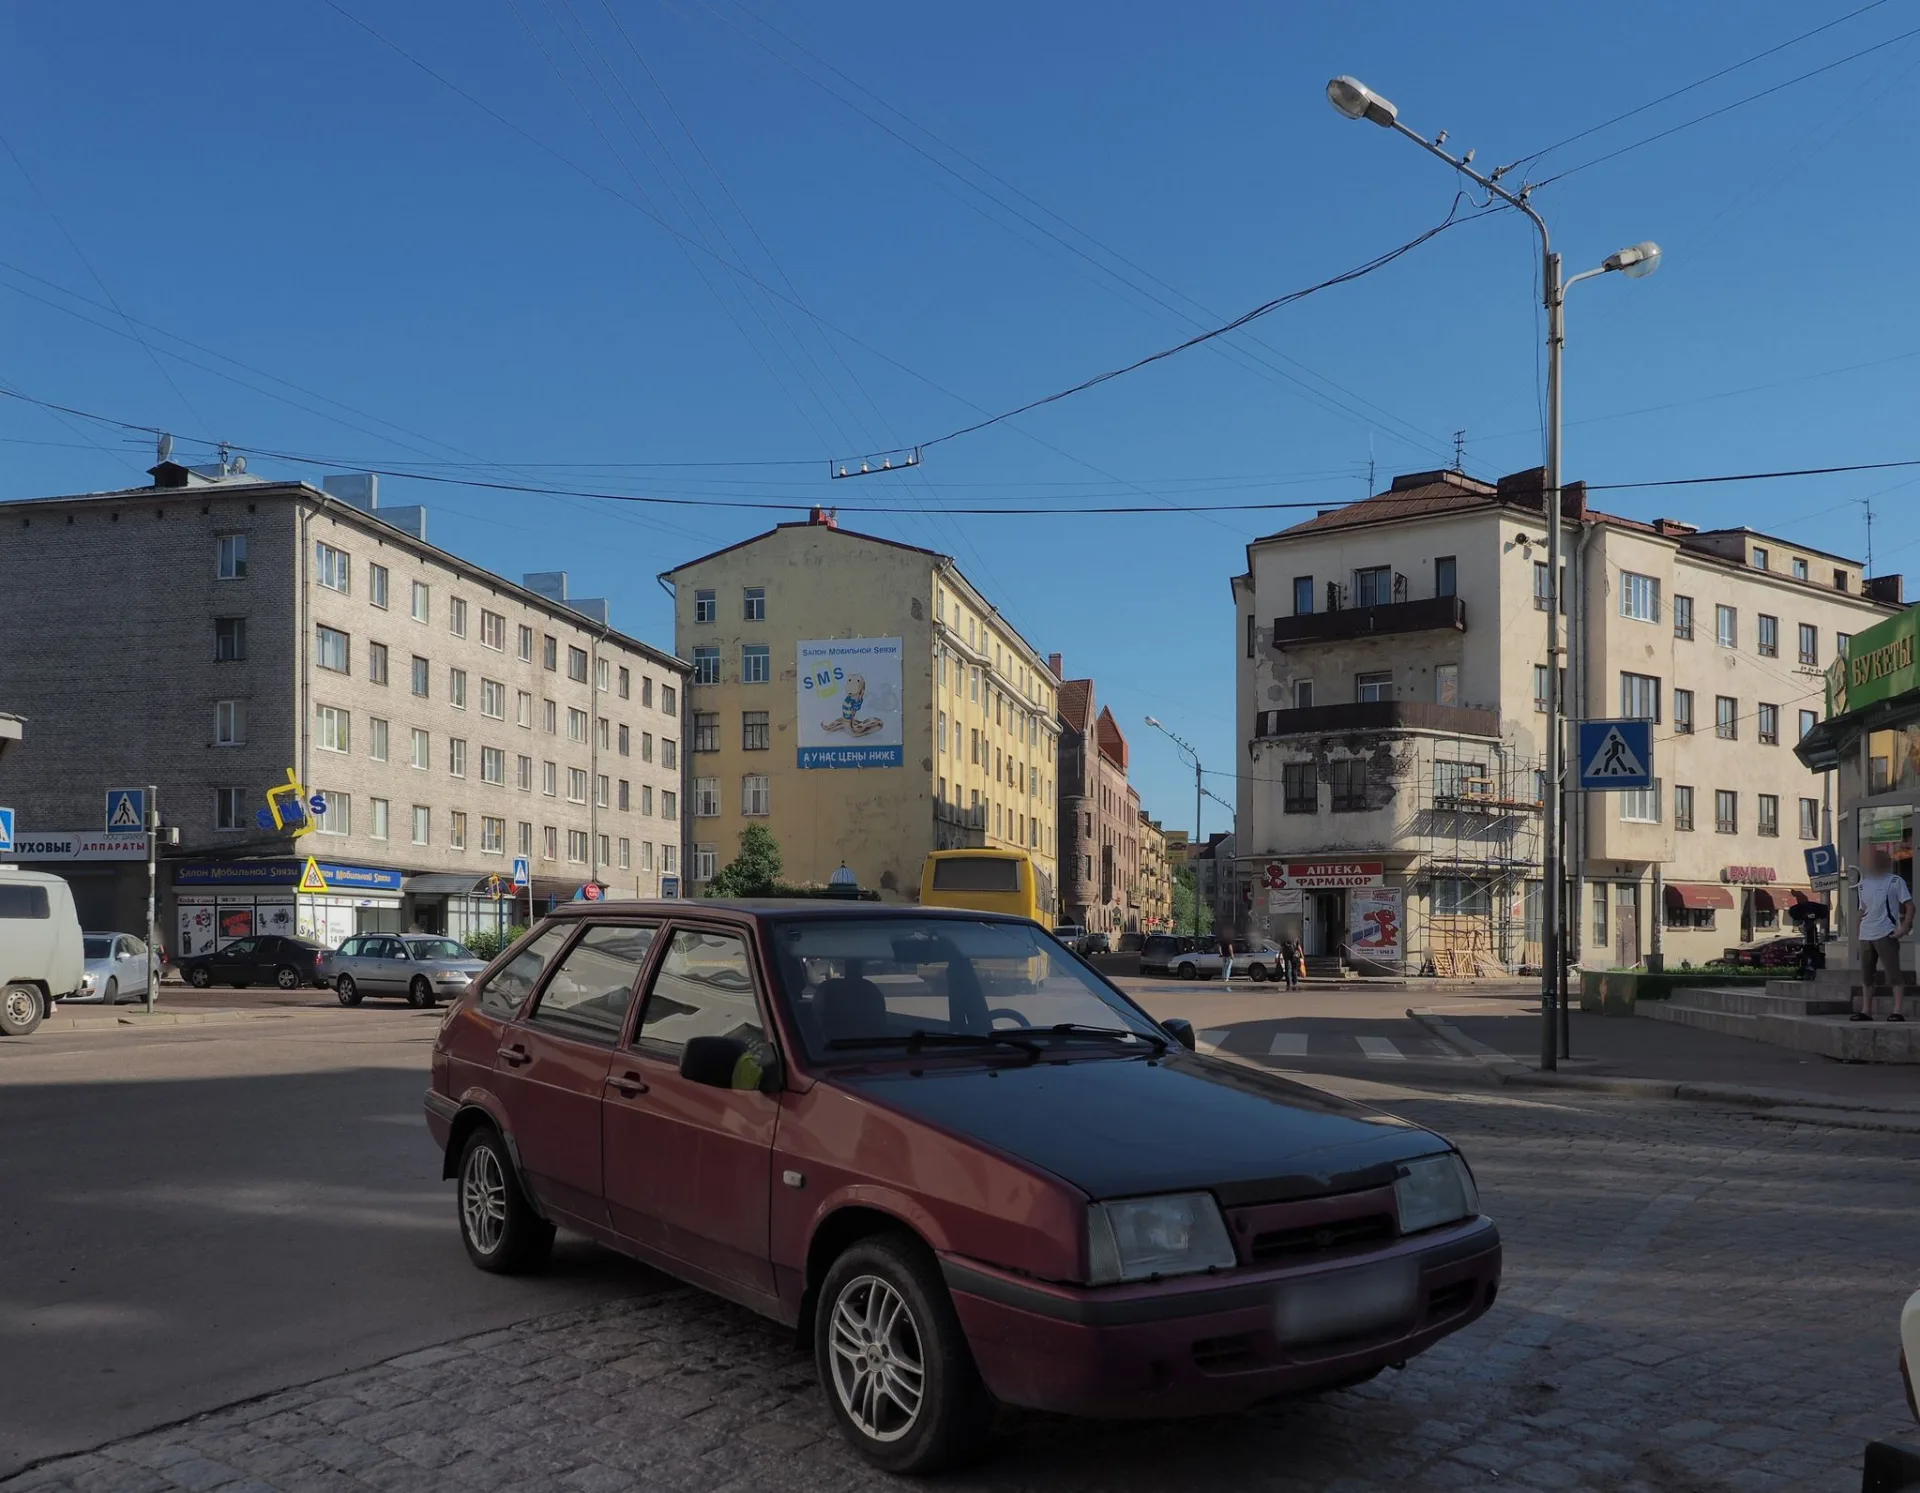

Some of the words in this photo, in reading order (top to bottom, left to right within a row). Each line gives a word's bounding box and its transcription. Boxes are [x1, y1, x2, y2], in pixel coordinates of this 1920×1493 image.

[1853, 635, 1913, 687] БУКЕТЫ
[803, 667, 844, 690] SMS
[804, 752, 810, 762] А
[811, 752, 818, 762] У
[819, 752, 836, 762] НАС
[838, 751, 866, 763] ЦЕНЫ
[869, 750, 896, 761] НИЖЕ
[13, 841, 72, 853] УХОВЫЕ
[83, 842, 145, 852] АППАРАТЫ
[1307, 864, 1363, 875] АПТЕКА
[1296, 876, 1372, 887] ФАРМАКОР
